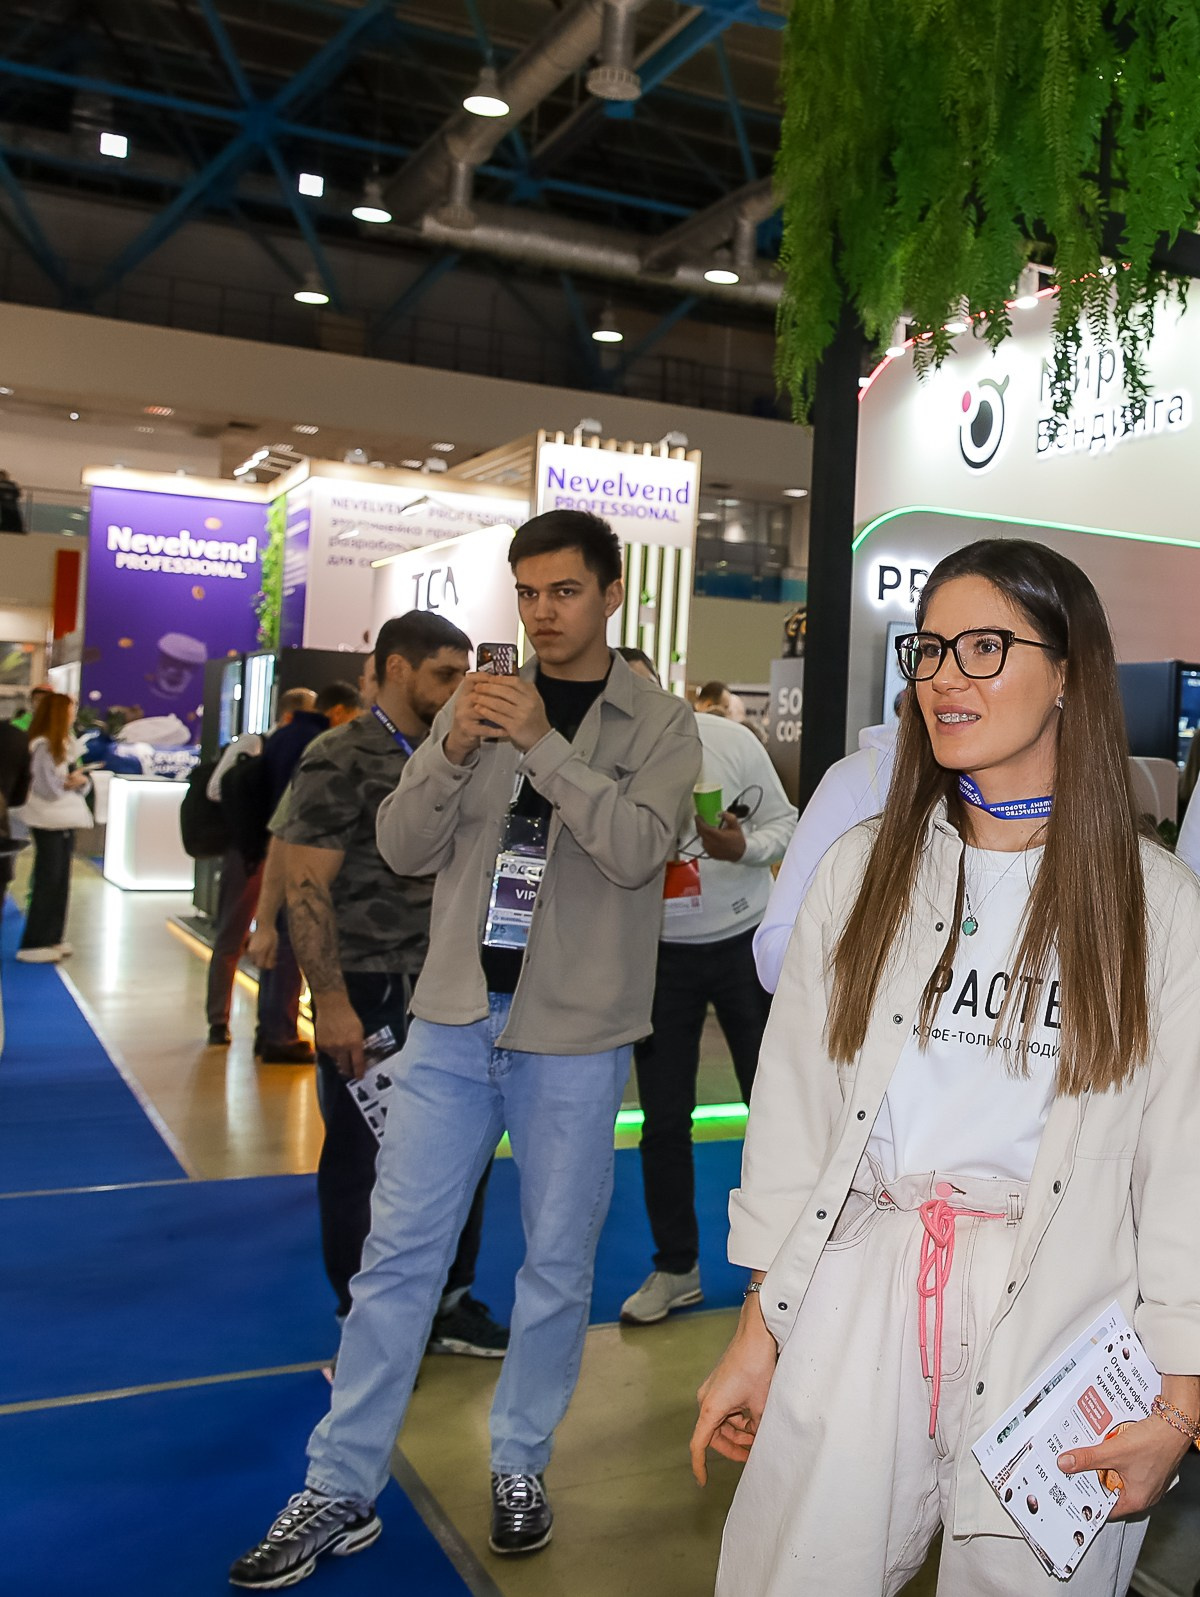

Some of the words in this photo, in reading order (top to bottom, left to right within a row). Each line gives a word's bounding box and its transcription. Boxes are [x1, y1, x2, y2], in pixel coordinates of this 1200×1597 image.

[547, 466, 690, 504] Nevelvend
[107, 525, 257, 563] Nevelvend
[115, 552, 247, 579] PROFESSIONAL
[515, 889, 537, 900] VIP
[1110, 1356, 1131, 1387] Открой
[1096, 1374, 1116, 1403] кухней
[1106, 1372, 1136, 1412] авторской
[1046, 1438, 1060, 1456] F301
[1034, 1464, 1049, 1482] F301
